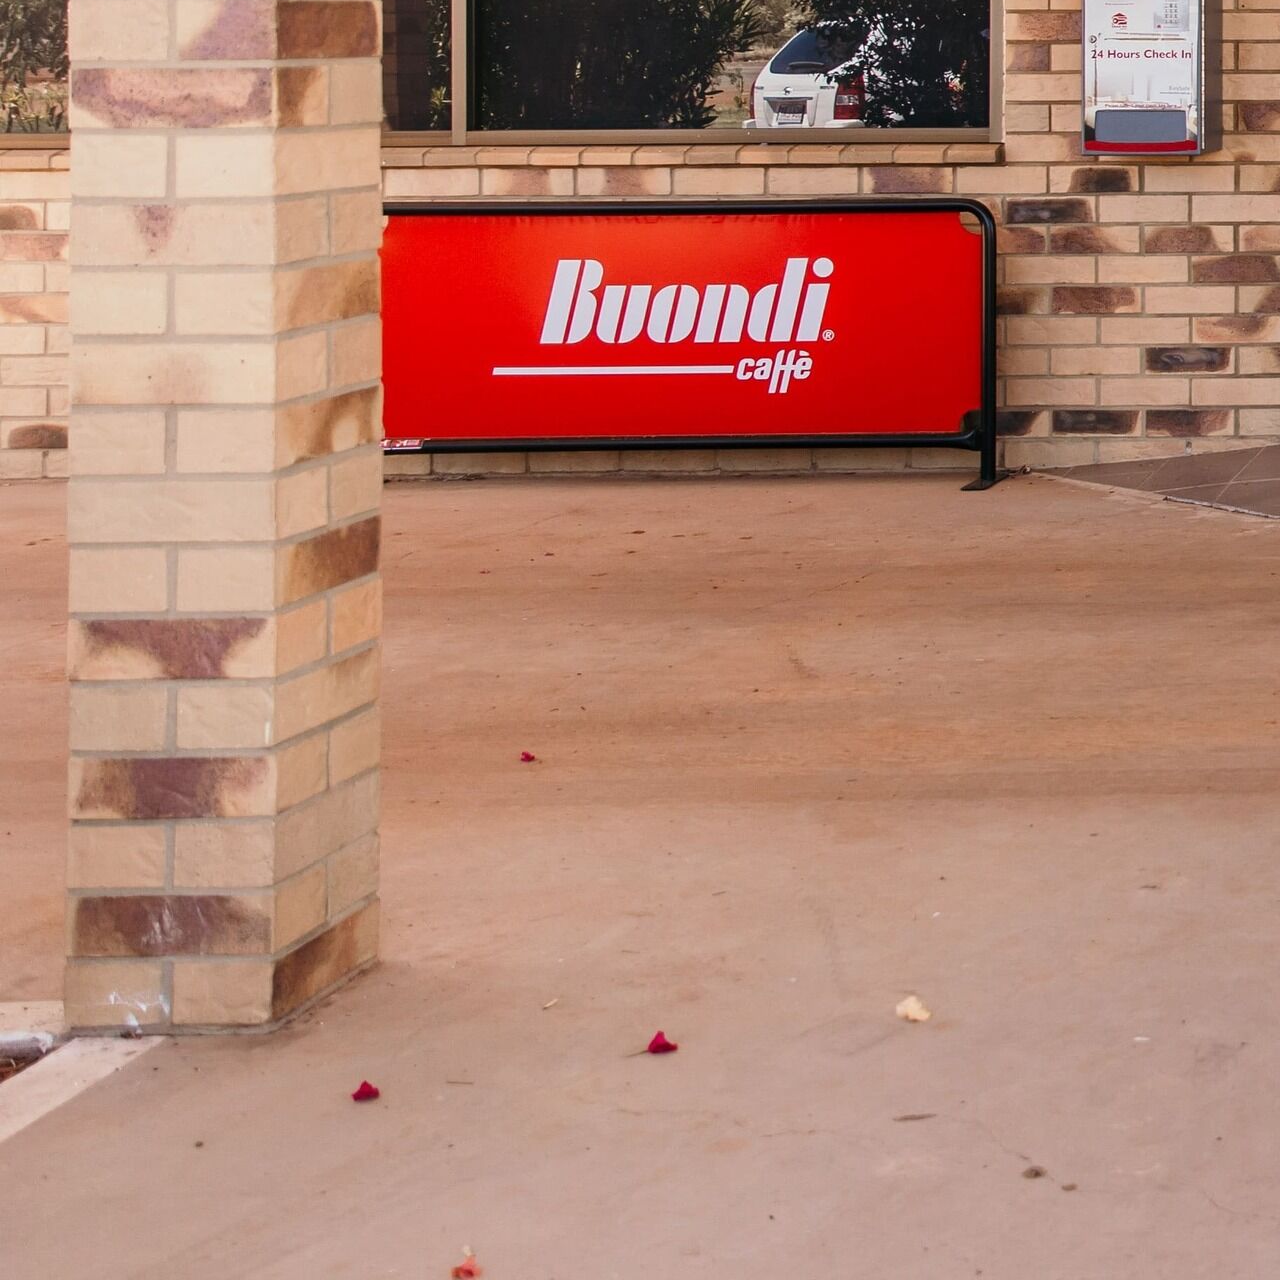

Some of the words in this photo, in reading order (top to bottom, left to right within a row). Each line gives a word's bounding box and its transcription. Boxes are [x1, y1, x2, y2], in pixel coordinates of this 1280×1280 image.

[1091, 50, 1104, 59] 24
[1107, 50, 1140, 59] Hours
[1144, 49, 1178, 59] Check
[1181, 50, 1192, 59] In
[538, 257, 834, 344] Buondi
[736, 350, 814, 394] caffè
